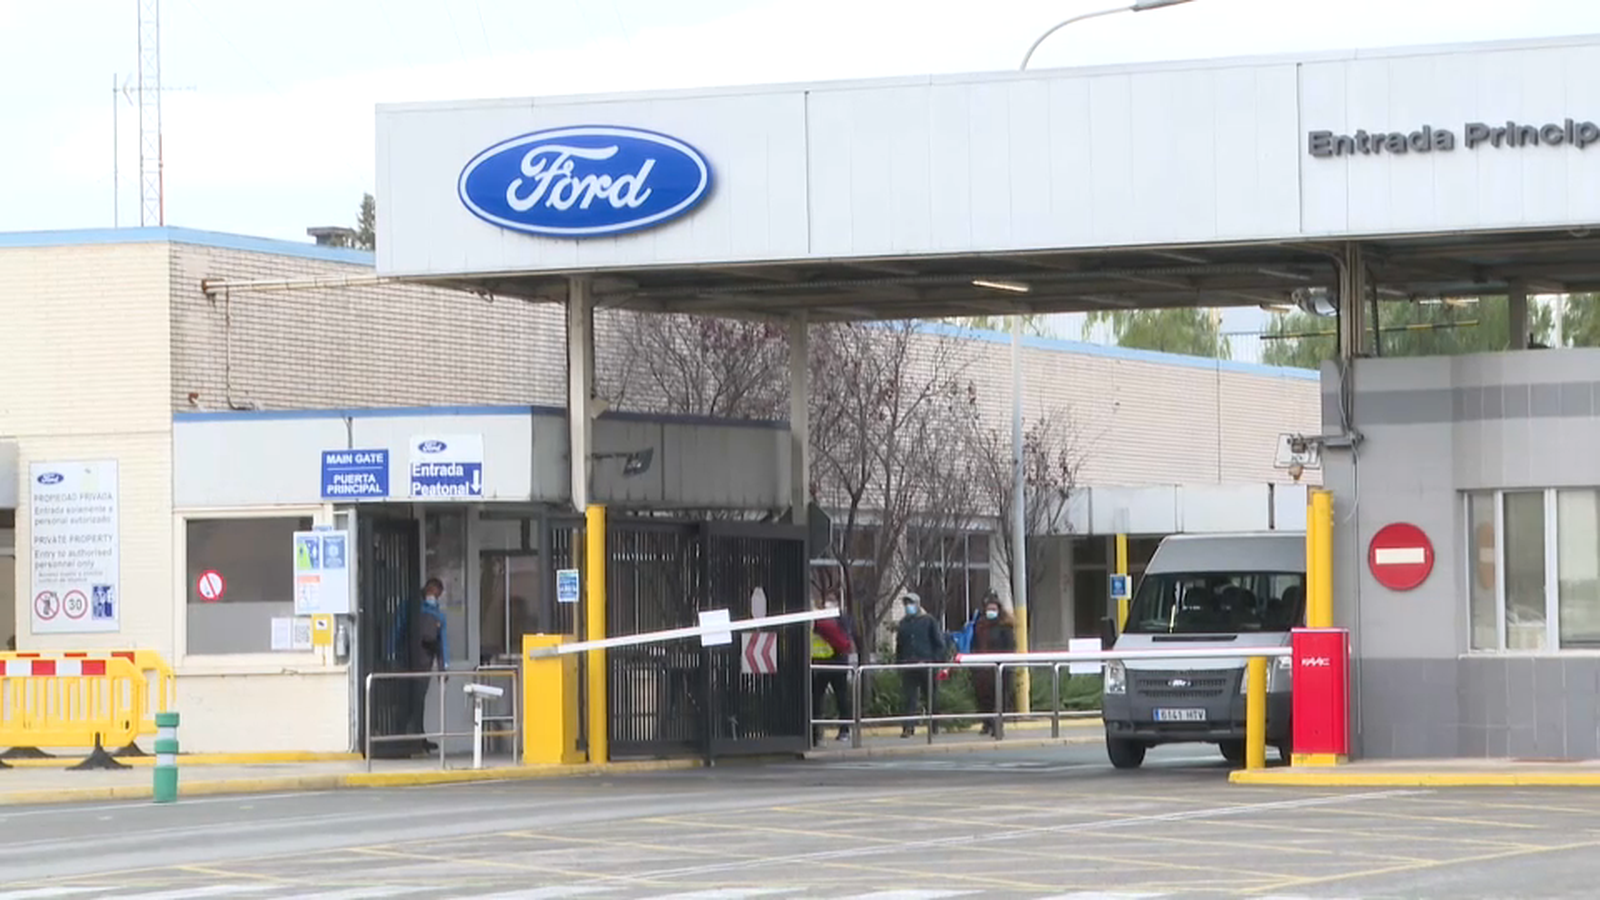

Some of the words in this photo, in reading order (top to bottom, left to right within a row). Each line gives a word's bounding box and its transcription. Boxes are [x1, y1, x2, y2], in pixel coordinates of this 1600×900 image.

[1308, 124, 1455, 157] Entrada
[506, 144, 656, 212] Ford
[326, 453, 353, 464] MAIN
[355, 453, 384, 464] GATE
[412, 463, 463, 477] Entrada
[333, 474, 376, 484] PUERTA
[326, 484, 382, 495] PRINCIPAL
[412, 482, 469, 496] Peatonal
[34, 492, 78, 502] PROPIEDAD
[79, 492, 113, 501] PRIVADA
[34, 506, 65, 515] Entrada
[34, 534, 67, 545] PRIVATE
[69, 533, 113, 544] PROPERTY
[34, 550, 56, 559] Entry
[58, 550, 67, 558] to
[68, 548, 112, 558] authorised
[34, 560, 75, 570] personnel
[76, 559, 95, 569] only
[69, 598, 82, 611] 30
